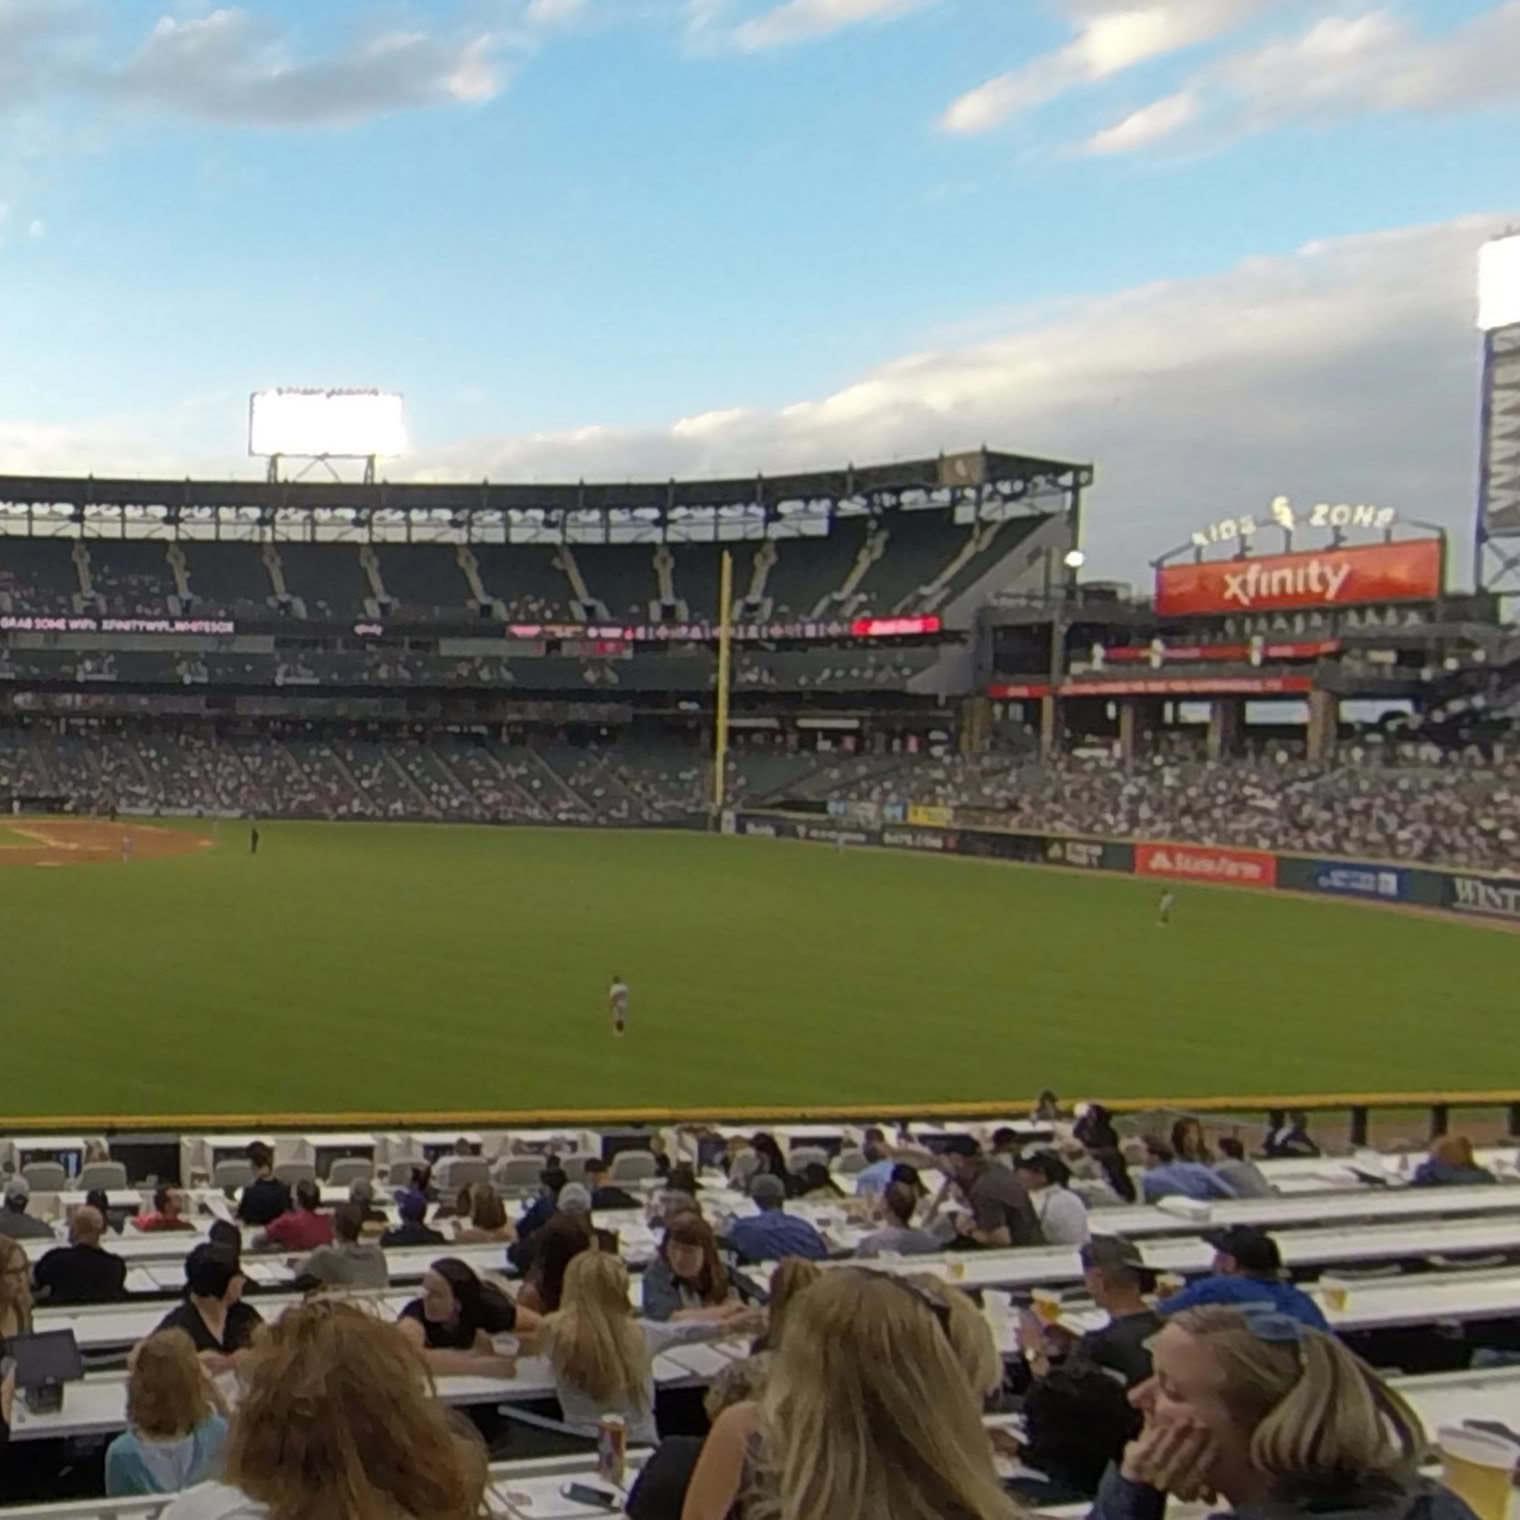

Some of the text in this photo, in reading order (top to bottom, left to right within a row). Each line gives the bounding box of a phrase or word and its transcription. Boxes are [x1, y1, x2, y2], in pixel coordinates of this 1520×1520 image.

[1191, 514, 1257, 546] KIDS
[1308, 504, 1396, 529] ZONE
[1223, 560, 1351, 606] xfinity
[0, 616, 32, 630] GRAB
[34, 617, 66, 631] SOME
